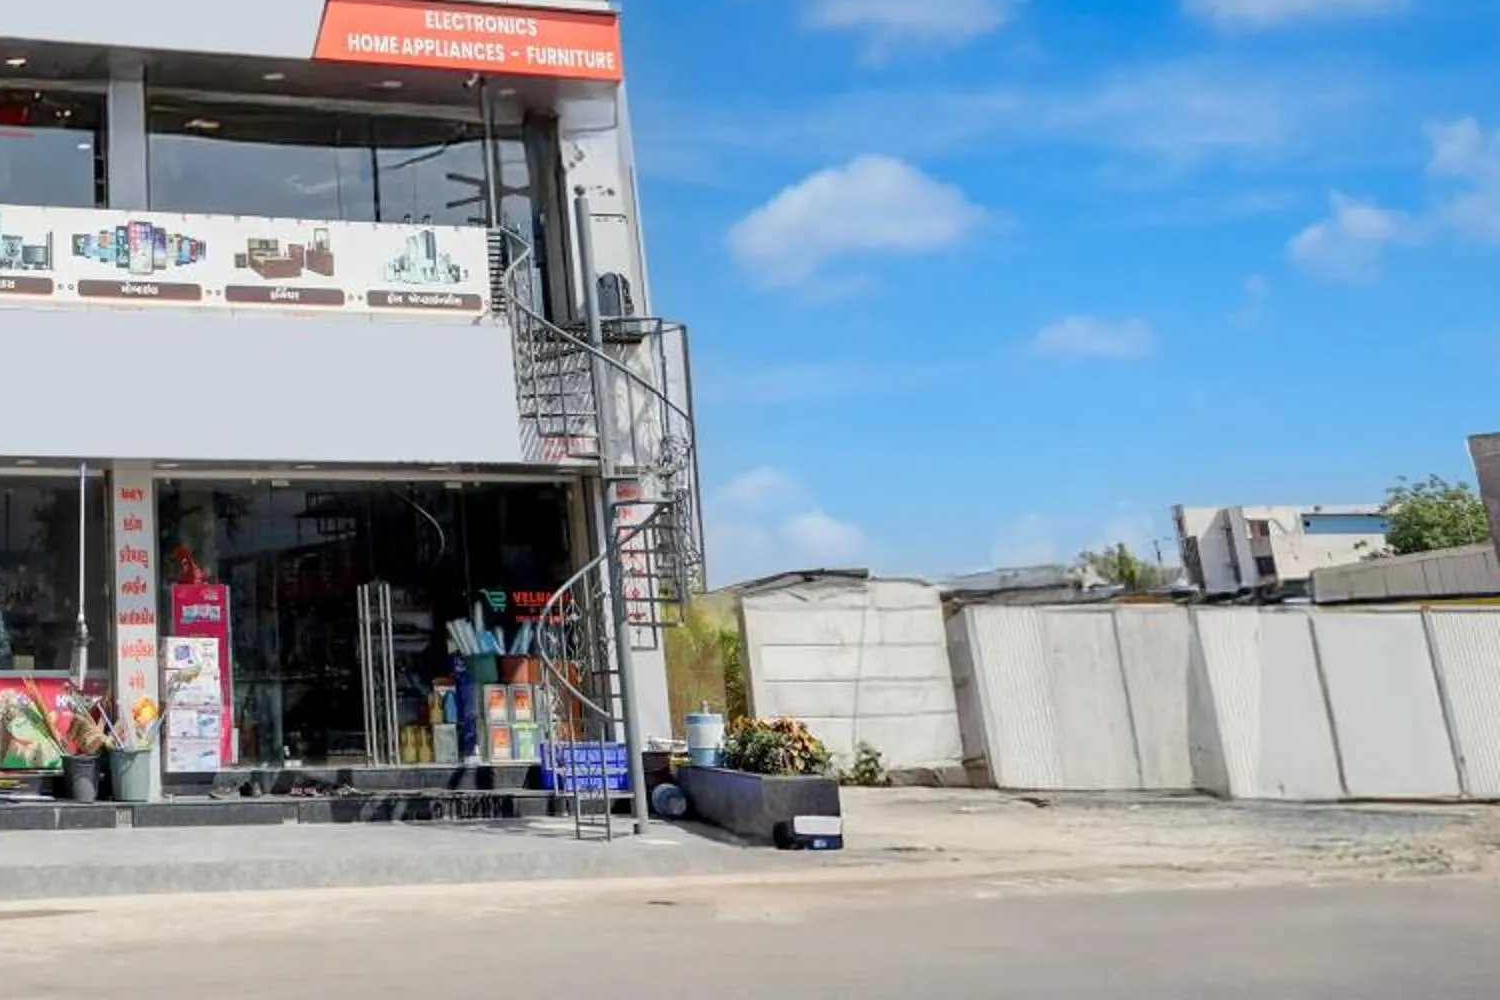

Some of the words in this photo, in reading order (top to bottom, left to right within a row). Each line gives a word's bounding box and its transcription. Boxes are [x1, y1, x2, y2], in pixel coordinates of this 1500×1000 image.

[424, 9, 538, 37] ELECTRONICS
[347, 32, 399, 55] HOME
[401, 38, 506, 64] APPLIANCES
[526, 45, 616, 71] FURNITURE
